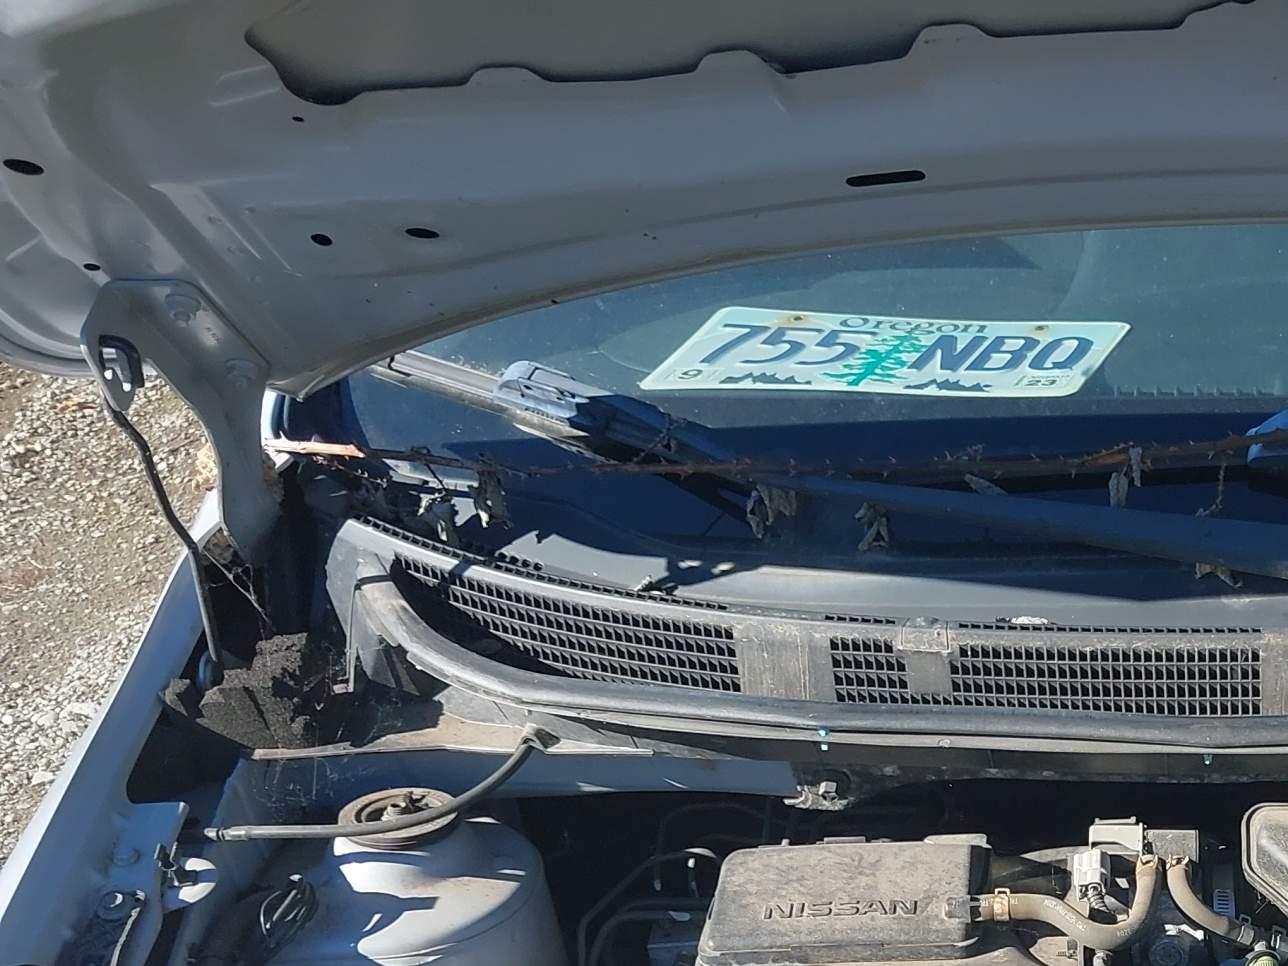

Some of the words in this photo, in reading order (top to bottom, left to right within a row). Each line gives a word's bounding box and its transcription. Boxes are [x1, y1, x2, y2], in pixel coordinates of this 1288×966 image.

[840, 315, 989, 337] Oregon
[698, 323, 874, 366] 755
[908, 334, 1096, 374] NBQ
[677, 368, 704, 381] 9
[1024, 377, 1058, 387] 23
[763, 899, 919, 920] NISSAN
